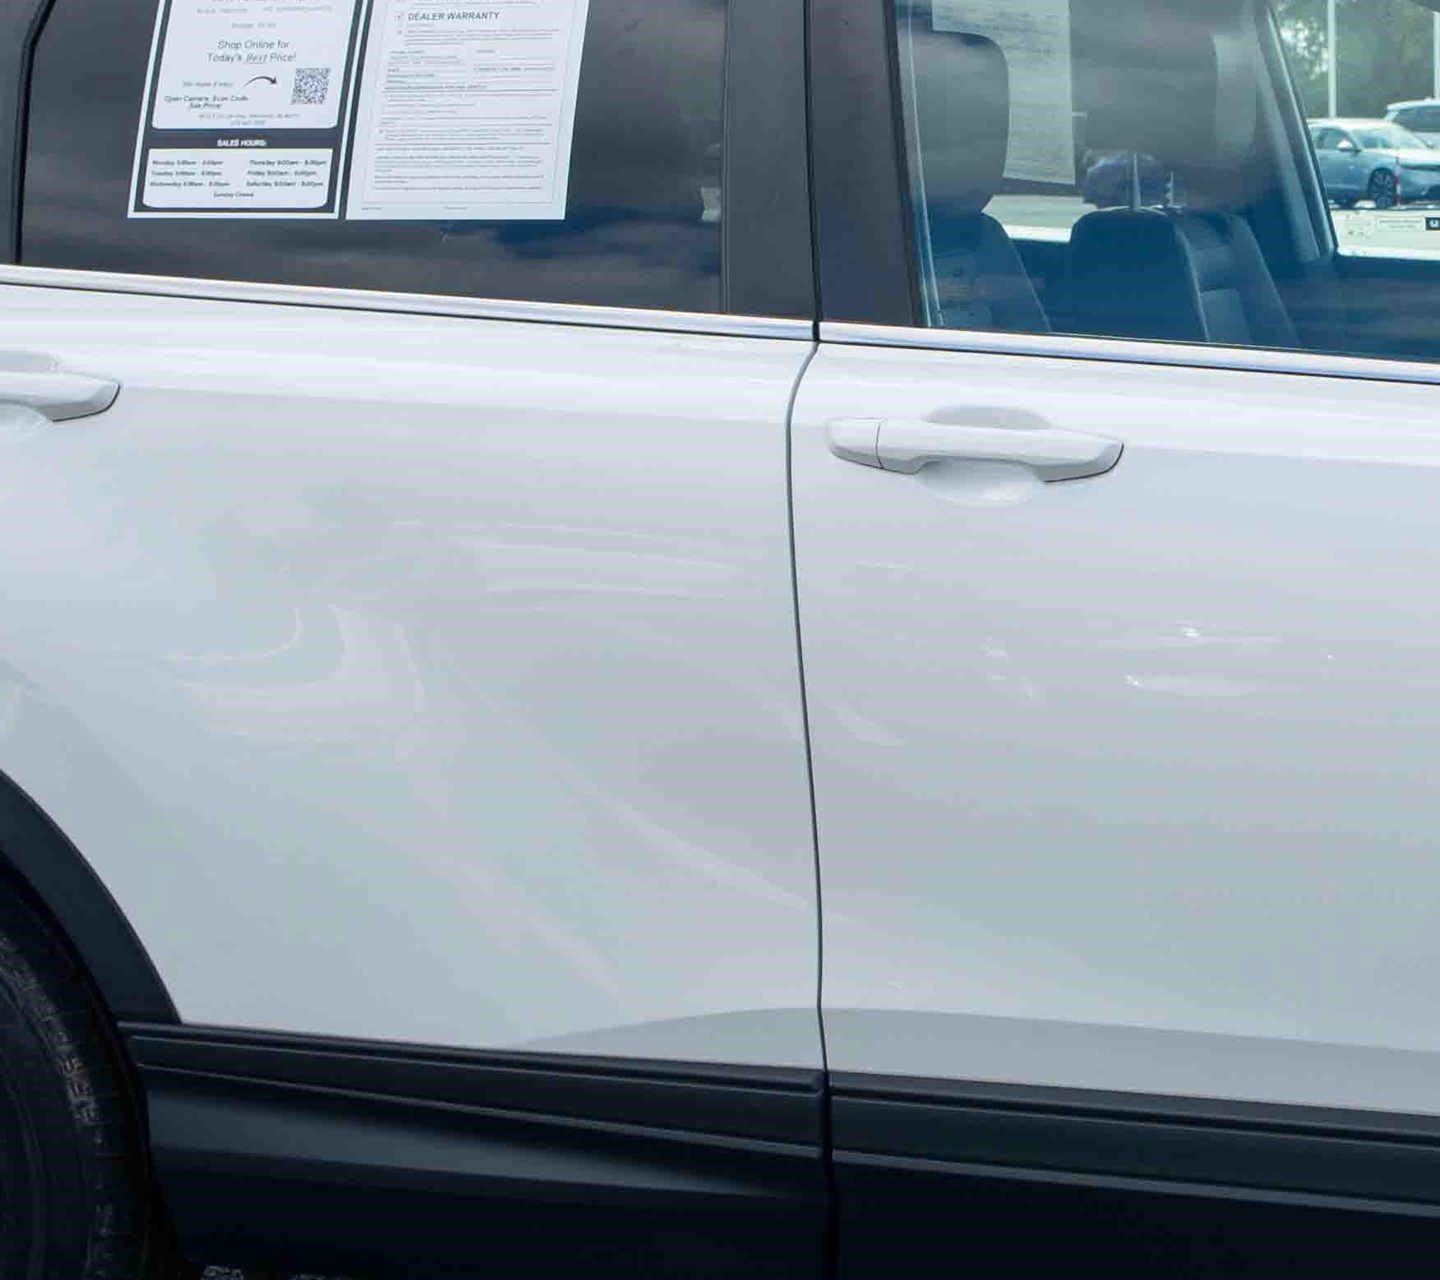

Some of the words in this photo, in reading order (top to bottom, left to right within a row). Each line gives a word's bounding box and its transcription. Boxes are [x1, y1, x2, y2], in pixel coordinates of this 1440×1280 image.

[407, 12, 446, 21] DEALER
[447, 11, 501, 21] WARRANTY
[217, 40, 242, 51] Shop
[244, 39, 275, 49] Online
[277, 39, 290, 49] for
[207, 53, 242, 63] Today's
